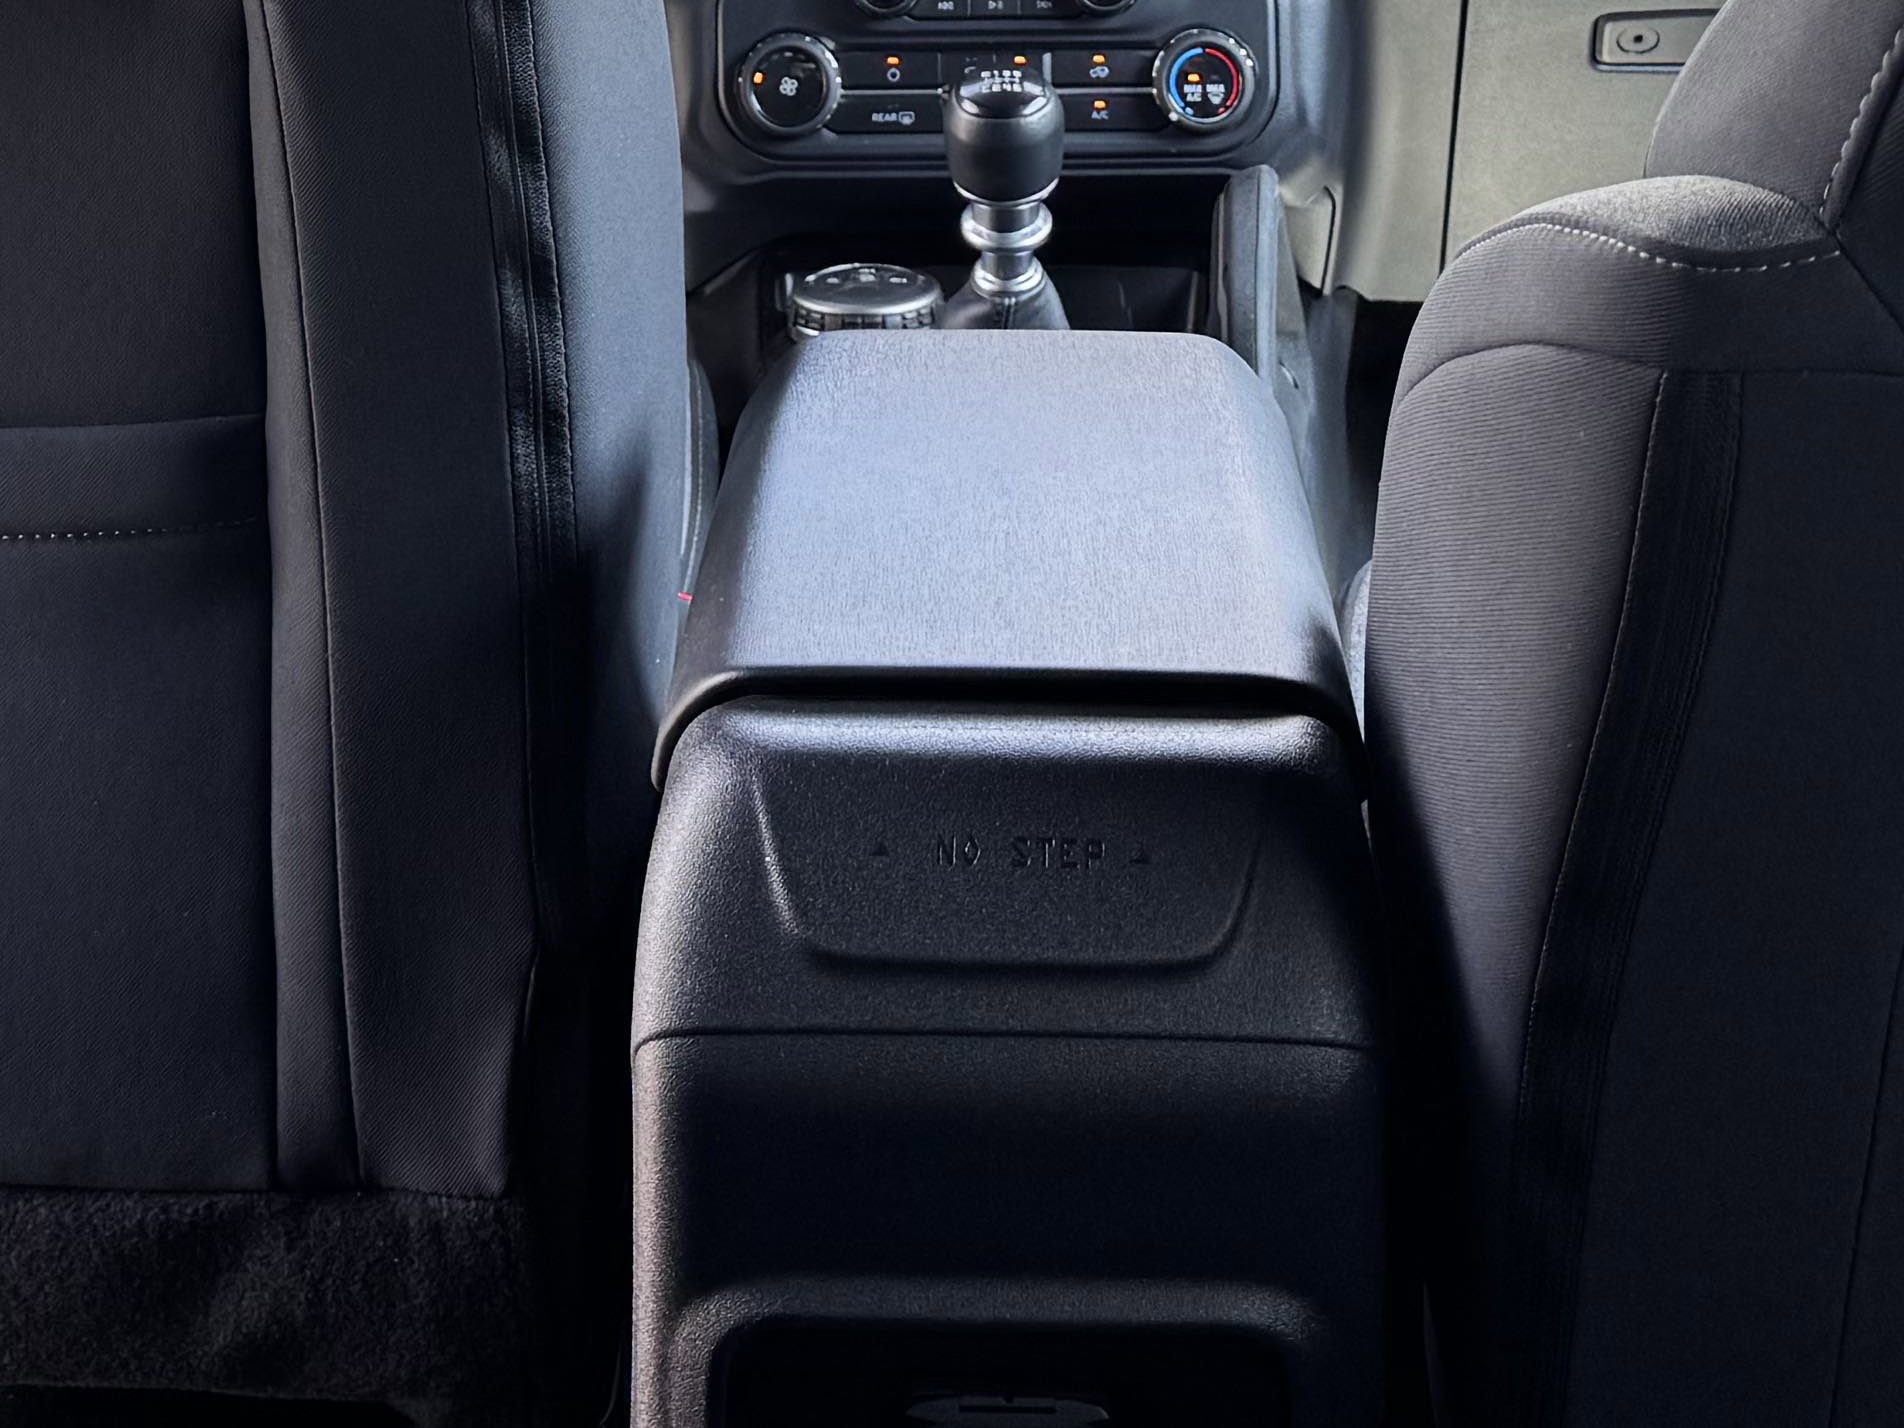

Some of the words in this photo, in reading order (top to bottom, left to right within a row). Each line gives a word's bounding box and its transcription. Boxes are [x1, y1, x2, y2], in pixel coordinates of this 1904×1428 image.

[871, 112, 897, 123] REAR
[1091, 109, 1109, 121] A/C
[937, 834, 981, 866] NO
[1011, 836, 1105, 868] STEP
